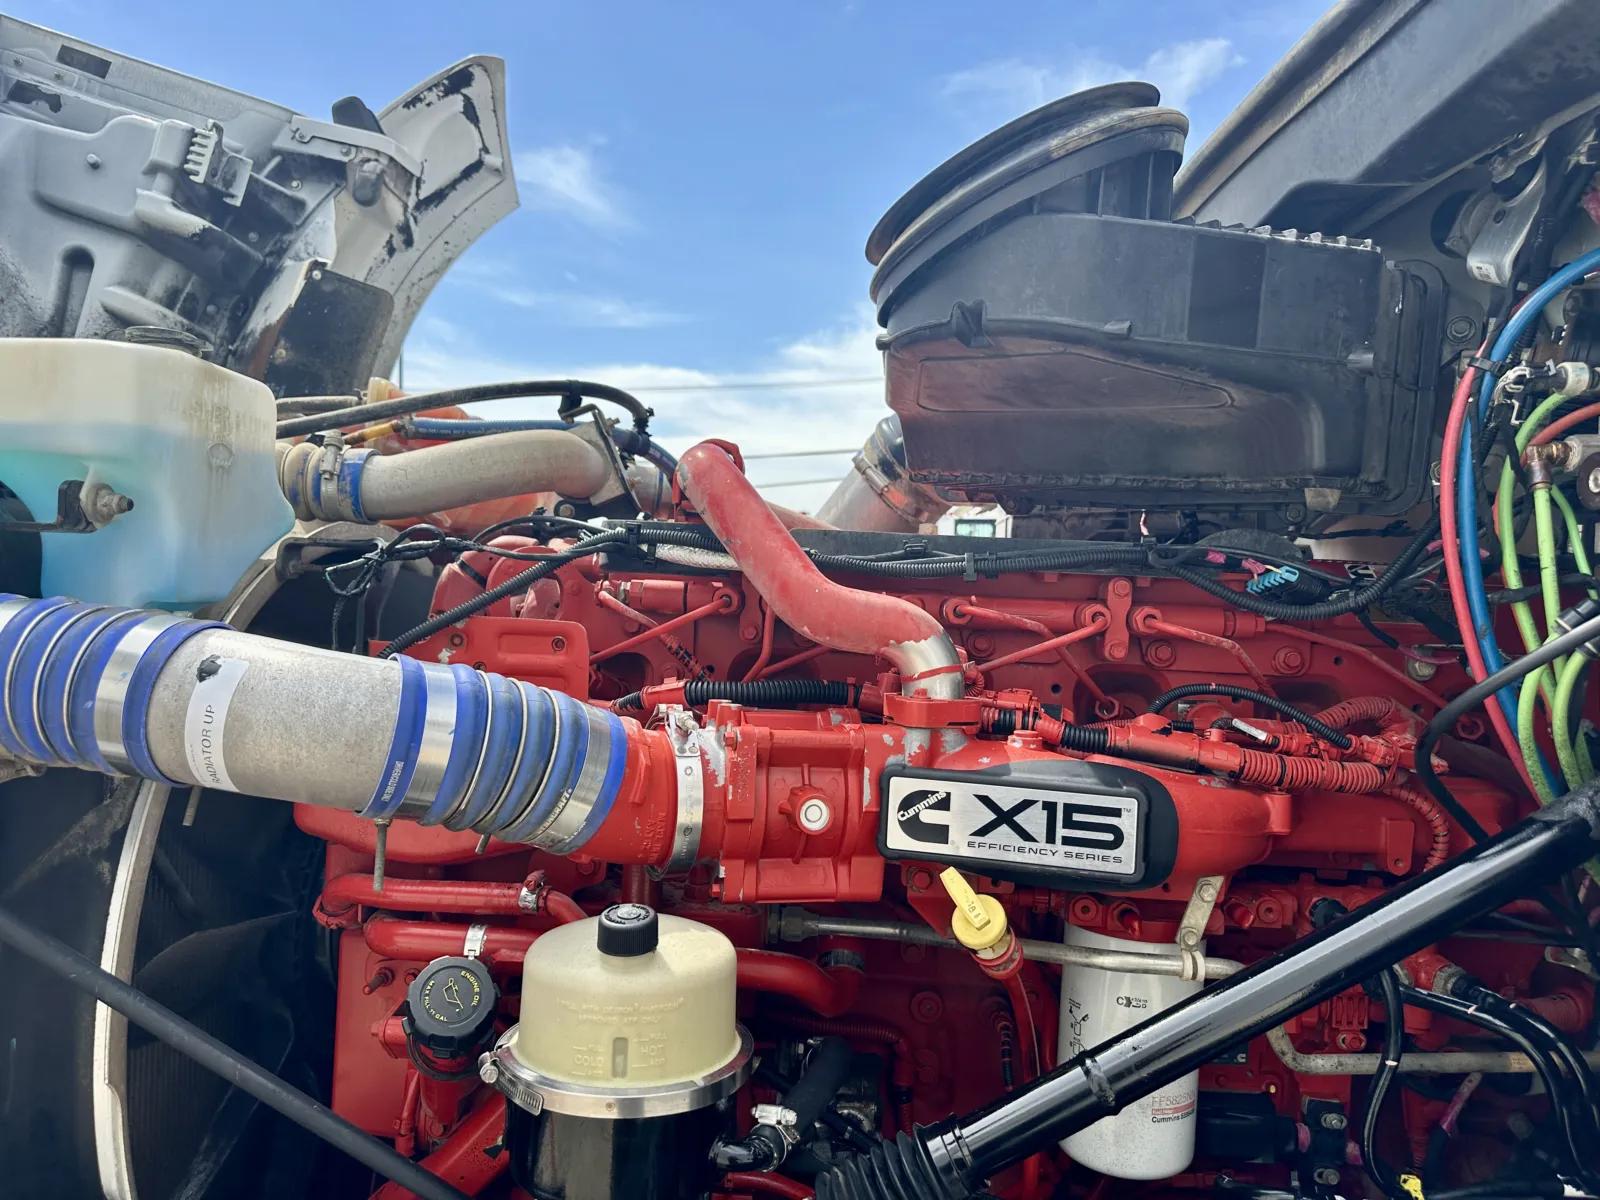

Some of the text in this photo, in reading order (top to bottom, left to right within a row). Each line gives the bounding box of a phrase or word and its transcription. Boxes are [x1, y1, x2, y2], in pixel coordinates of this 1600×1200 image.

[201, 704, 222, 784] RADIATOR UP
[897, 790, 947, 822] Cummins
[968, 793, 1125, 851] X15
[967, 840, 1123, 864] EFFICIENCY SERIES
[424, 980, 435, 994] MAX
[435, 1013, 448, 1022] GAL
[460, 970, 480, 1007] ENGINE OIL
[574, 1054, 605, 1067] COLD
